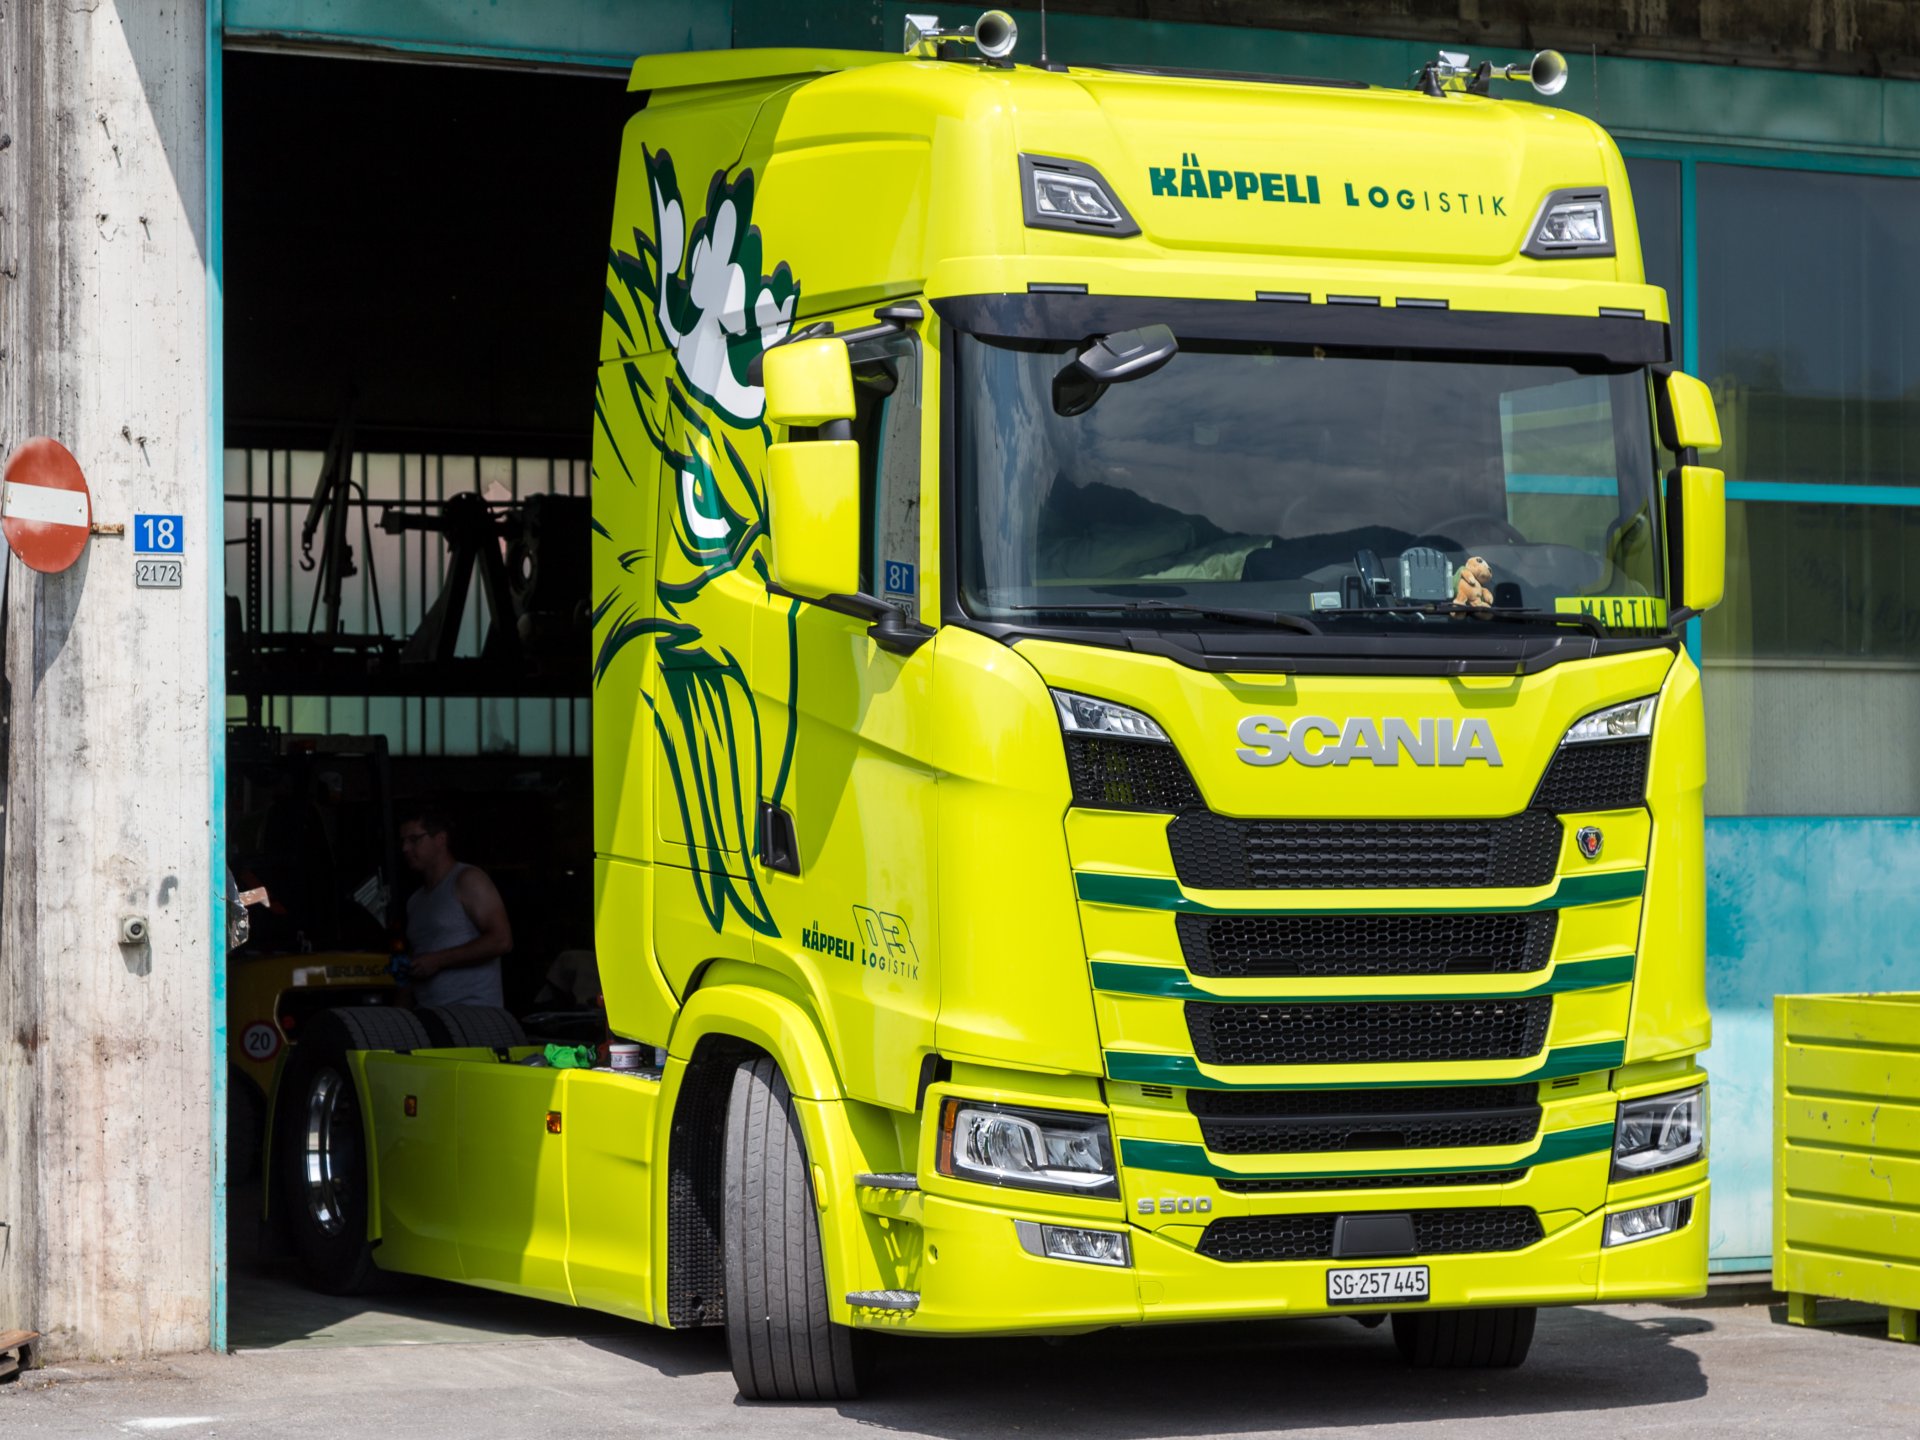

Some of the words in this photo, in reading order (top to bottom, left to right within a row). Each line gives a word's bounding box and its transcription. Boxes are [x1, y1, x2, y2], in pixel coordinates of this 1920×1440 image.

[1149, 153, 1320, 204] KÄPPELI
[1344, 181, 1507, 217] LOGISTIK
[142, 518, 175, 549] 18
[141, 565, 177, 582] 2172
[1580, 599, 1658, 628] MARTIN
[1235, 715, 1503, 767] SCANIA
[802, 920, 854, 962] KÄPPELI
[862, 948, 919, 981] LOGISTIK
[249, 1032, 271, 1051] 20
[1137, 1198, 1155, 1213] S
[1159, 1196, 1212, 1213] 500
